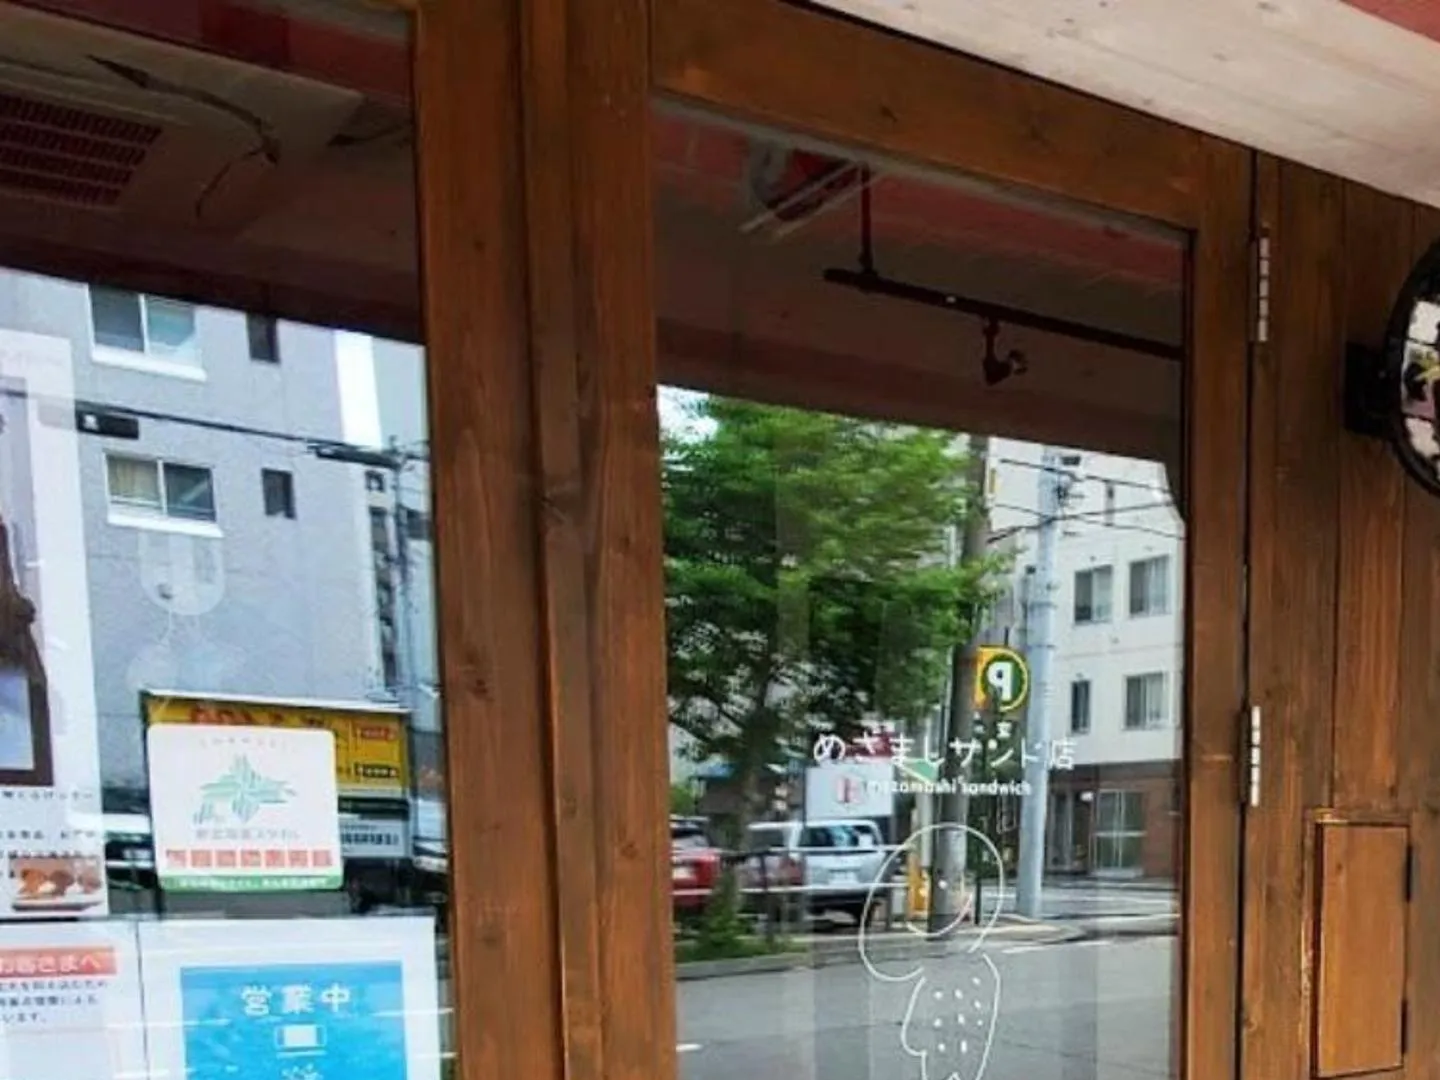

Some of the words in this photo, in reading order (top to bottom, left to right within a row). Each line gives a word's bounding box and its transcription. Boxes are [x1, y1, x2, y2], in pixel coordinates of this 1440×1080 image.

[812, 731, 1078, 771] めざましサンド店
[241, 981, 352, 1017] 営業中
